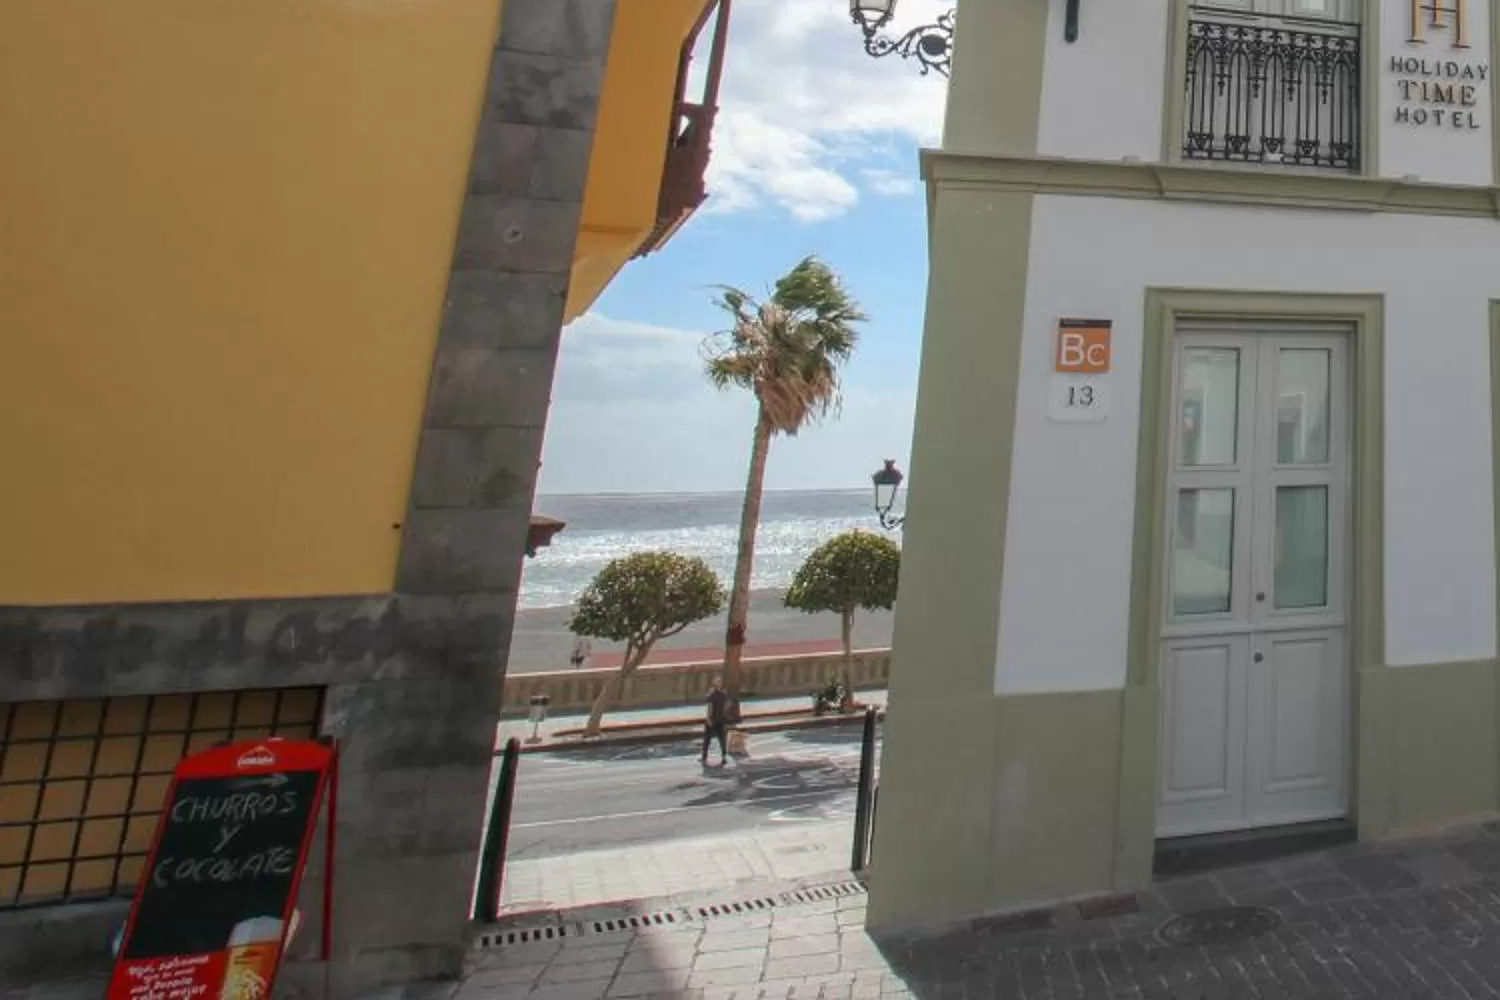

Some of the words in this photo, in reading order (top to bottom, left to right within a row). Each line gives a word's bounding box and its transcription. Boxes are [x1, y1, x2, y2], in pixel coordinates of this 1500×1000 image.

[1390, 56, 1488, 81] HOLIDAY
[1398, 79, 1476, 106] TIME
[1395, 106, 1480, 129] HOTEL
[1068, 385, 1094, 407] 13
[171, 791, 298, 823] CHURROS
